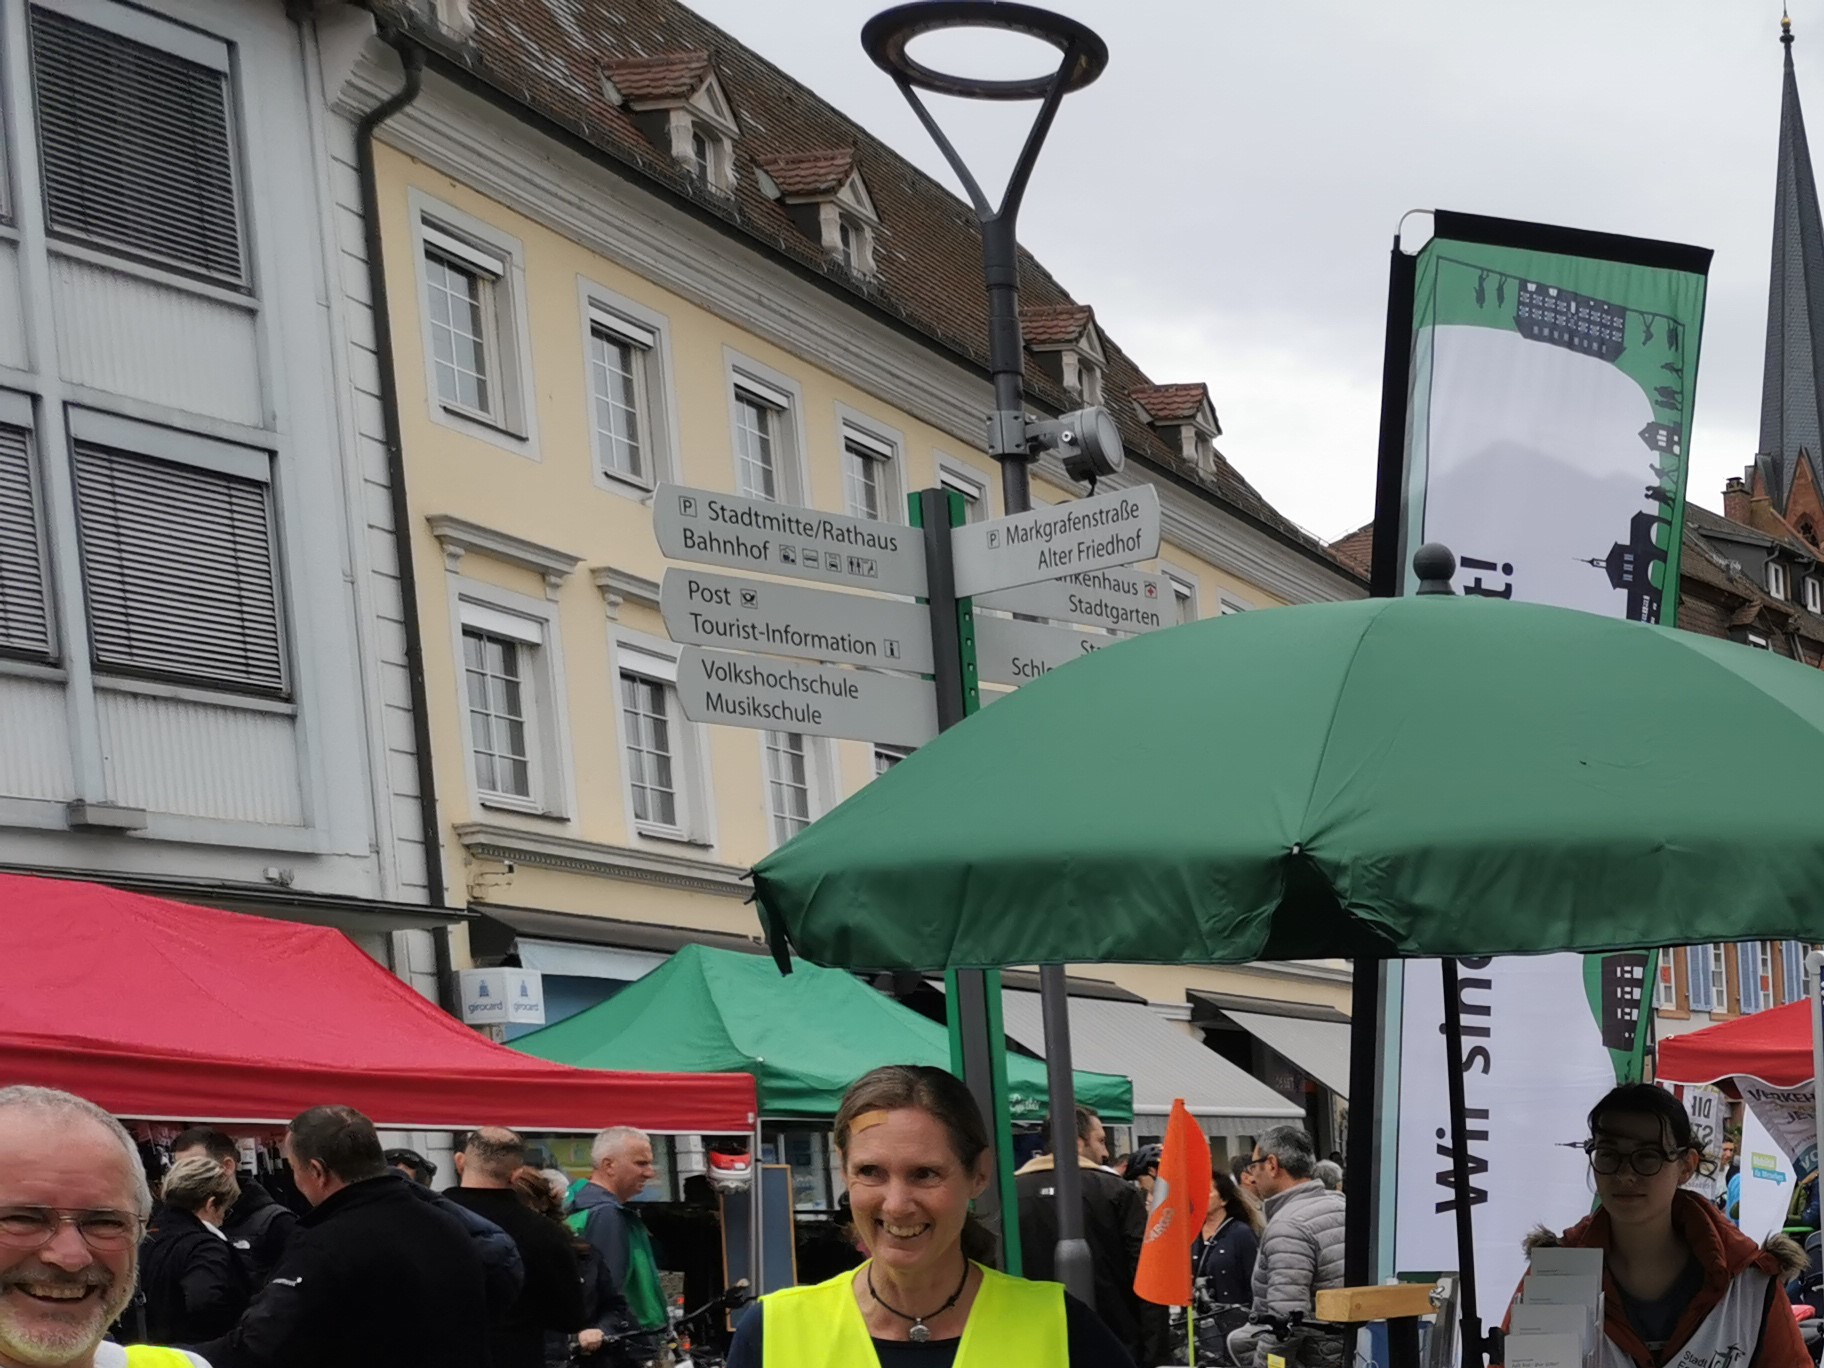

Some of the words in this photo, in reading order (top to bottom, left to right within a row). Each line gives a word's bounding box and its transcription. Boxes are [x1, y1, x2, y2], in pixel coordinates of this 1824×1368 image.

[708, 500, 898, 552] Stadtmitte/Rathaus
[1006, 499, 1139, 546] Markgrafenstraße
[683, 528, 770, 561] Bahnhof
[1038, 548, 1073, 570] Alter
[1077, 528, 1142, 562] Friedhof
[688, 580, 732, 607] Post
[1056, 572, 1139, 596] nkenhaus
[1068, 594, 1160, 627] Stadtgarten
[688, 612, 877, 656] Tourist-Information
[1080, 640, 1101, 658] St
[701, 658, 859, 699] Volkshochschule
[705, 691, 822, 725] Musikschule
[468, 1001, 503, 1014] girocard
[1440, 957, 1493, 1075] sin
[1748, 1088, 1815, 1104] VERKEH
